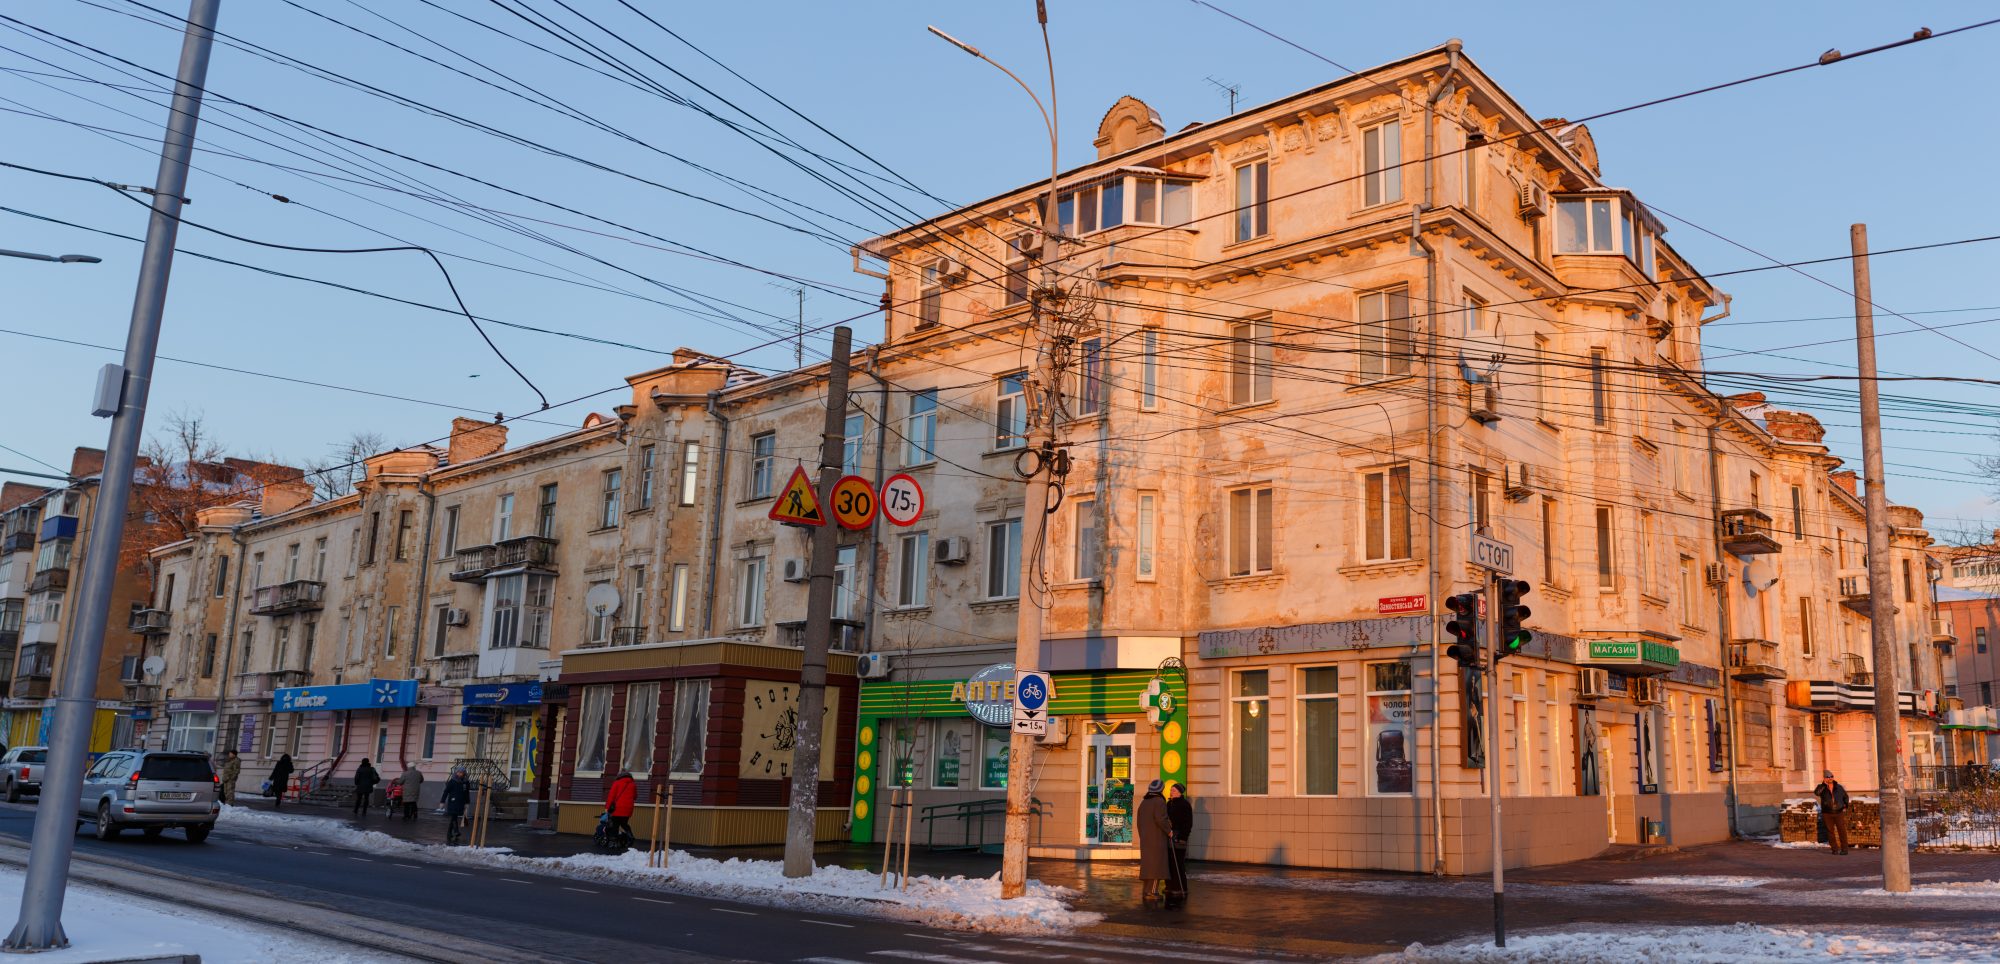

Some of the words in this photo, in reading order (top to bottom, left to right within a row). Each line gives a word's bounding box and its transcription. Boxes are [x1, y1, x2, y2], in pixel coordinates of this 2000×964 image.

[837, 490, 871, 517] 30
[1478, 541, 1510, 570] СТОП
[1413, 597, 1424, 608] 27
[1594, 644, 1636, 654] МАГАЗИН
[950, 677, 1057, 702] АПТЕА
[1103, 816, 1123, 826] SALE
